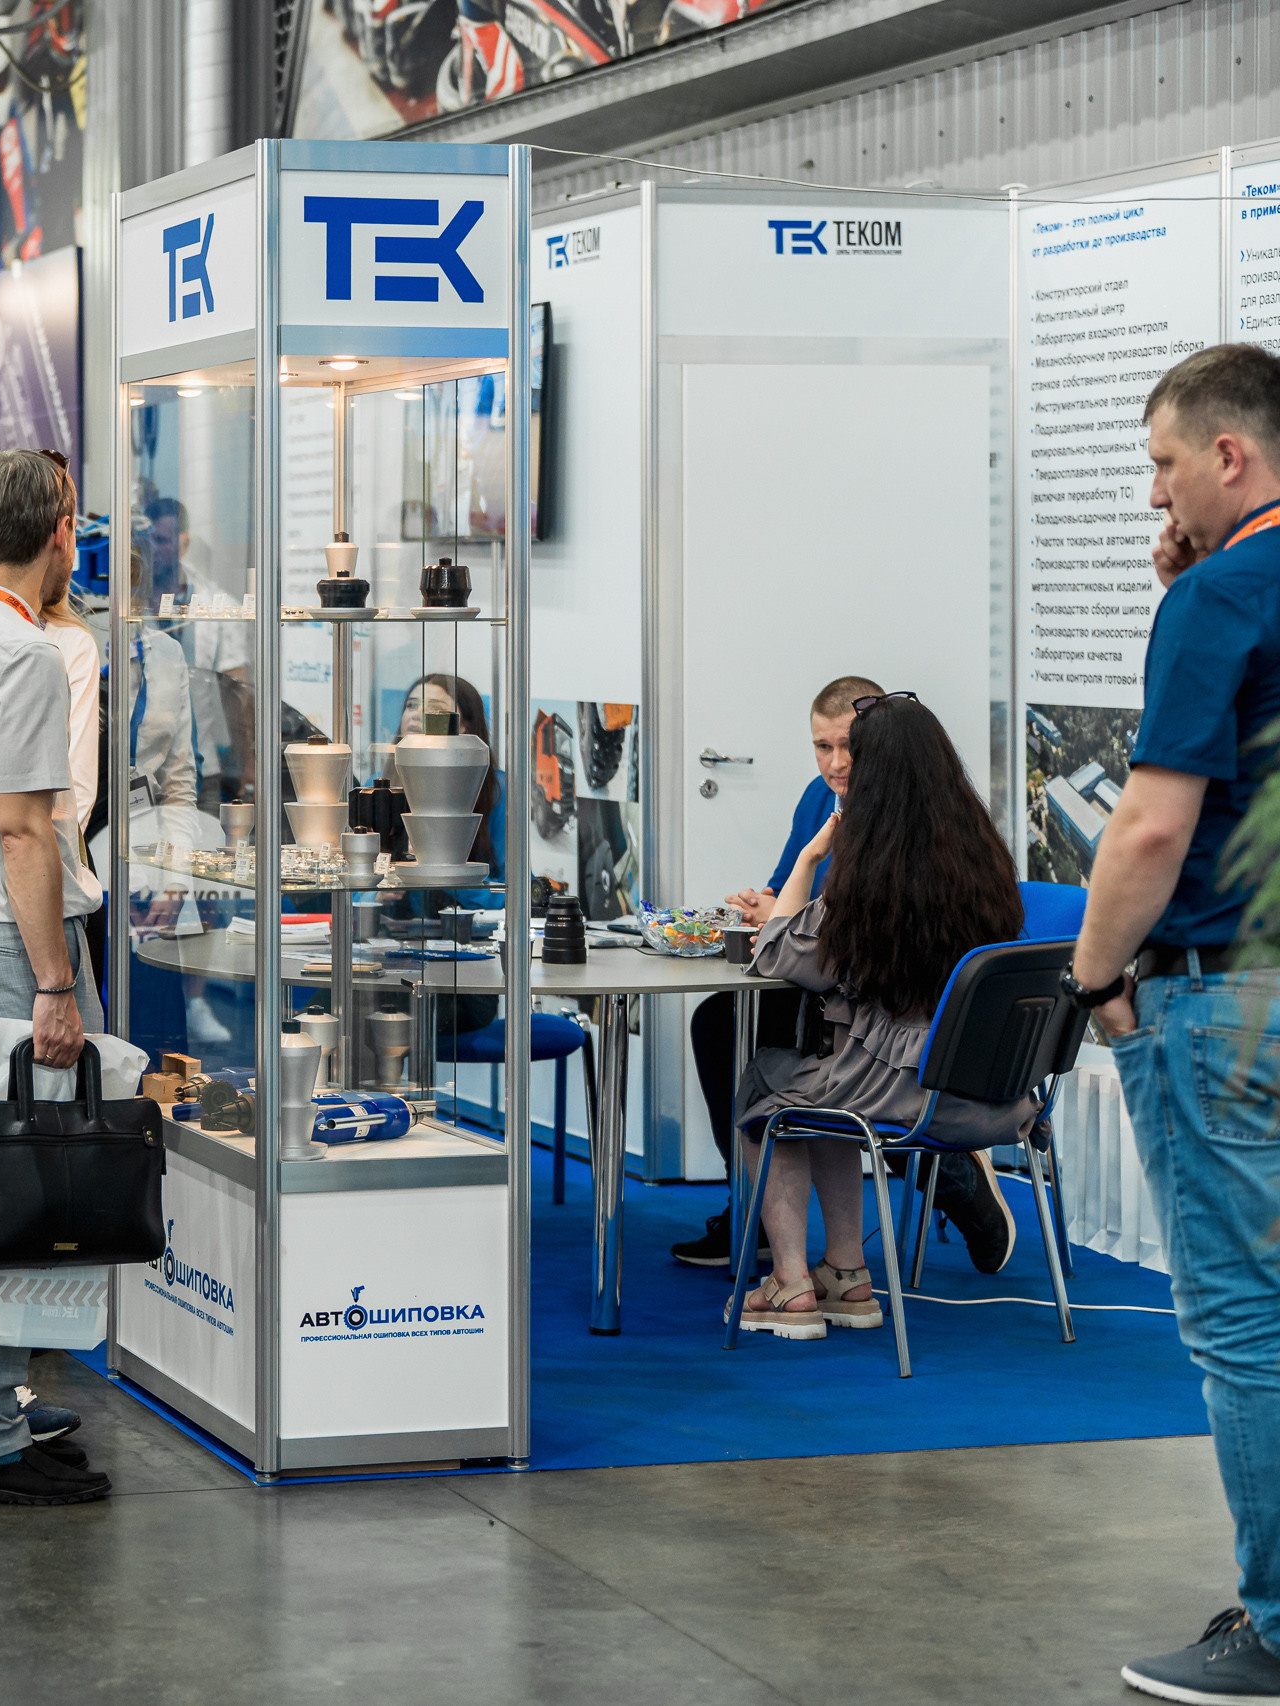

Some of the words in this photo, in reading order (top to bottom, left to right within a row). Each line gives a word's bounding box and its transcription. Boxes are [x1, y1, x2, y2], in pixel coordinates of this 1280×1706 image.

[1072, 217, 1085, 228] это
[1088, 209, 1120, 226] полный
[1123, 207, 1144, 220] цикл
[572, 226, 600, 256] ТЕКОМ
[832, 221, 902, 246] ТЕКОМ
[1043, 239, 1090, 258] разработки
[1092, 237, 1102, 248] до
[1105, 226, 1166, 246] производства
[1246, 247, 1280, 262] Уникал
[1241, 271, 1280, 287] произво
[1035, 281, 1102, 301] Конструкторский
[1104, 279, 1128, 292] отдел
[1240, 296, 1256, 310] для
[1035, 305, 1098, 324] Испытательный
[1101, 304, 1125, 316] центр
[1035, 331, 1086, 347] Лаборатория
[1088, 326, 1125, 341] входного
[1128, 321, 1168, 335] контроля
[1035, 350, 1105, 368] Механосборочное
[1107, 344, 1168, 362] производство
[1170, 339, 1205, 357] (сборка
[1031, 378, 1061, 392] станков
[1062, 372, 1117, 388] собственного
[1035, 398, 1109, 414] Инструментальное
[1035, 421, 1094, 436] Подразделение
[1035, 468, 1098, 482] Твердосплавное
[1100, 465, 1157, 479] производств
[1067, 488, 1117, 504] переработку
[1035, 513, 1116, 526] Холодновысадочное
[1035, 535, 1064, 548] Участок
[1066, 536, 1104, 549] токарных
[1106, 535, 1151, 546] автоматов
[1035, 558, 1089, 572] Производство
[1032, 583, 1114, 593] металлопластиковых
[1116, 579, 1152, 594] изделий
[1035, 602, 1089, 617] Производство
[1091, 602, 1119, 618] сборки
[1122, 605, 1151, 616] шипов
[1035, 625, 1089, 640] Производство
[1035, 647, 1084, 662] Лаборатория
[1087, 650, 1122, 662] качества
[1035, 669, 1064, 682] Участок
[1066, 673, 1102, 686] контроля
[1104, 672, 1137, 686] готовой
[144, 1246, 234, 1313] ВТОШИПОВКА
[300, 1305, 485, 1331] АВТОШИПОВКА
[300, 1333, 372, 1342] ПРОФЕССИОНАЛЬНАЯ
[373, 1331, 410, 1339] ОШИПОВКА
